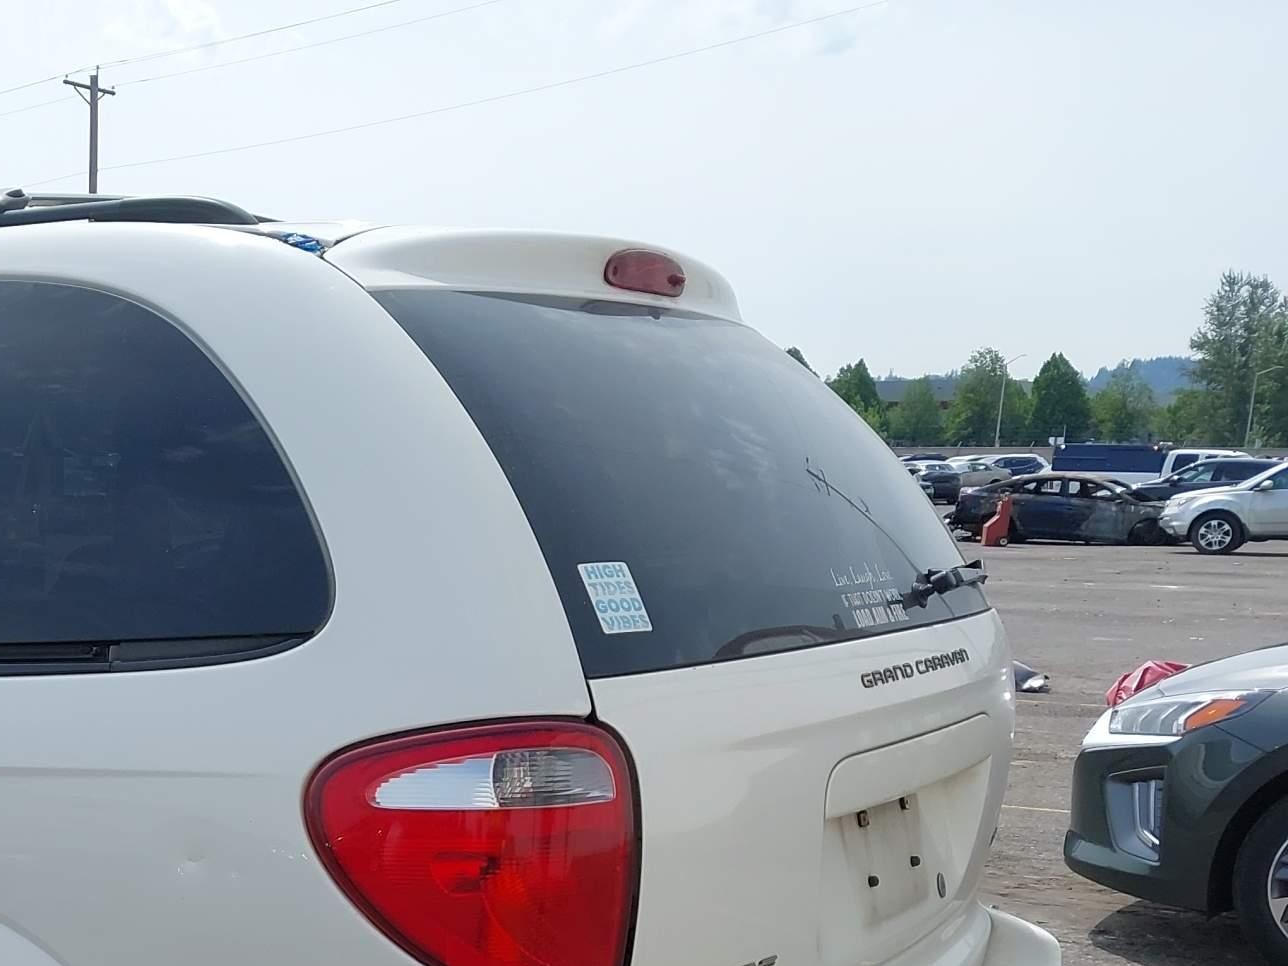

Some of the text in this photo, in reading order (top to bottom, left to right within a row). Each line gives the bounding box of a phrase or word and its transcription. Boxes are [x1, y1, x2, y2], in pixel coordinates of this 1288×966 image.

[583, 564, 626, 580] HIGH
[587, 580, 635, 597] TIDES
[595, 597, 643, 614] GOOD
[601, 614, 650, 631] VIBES
[861, 647, 970, 689] GRAND CARAVAN
